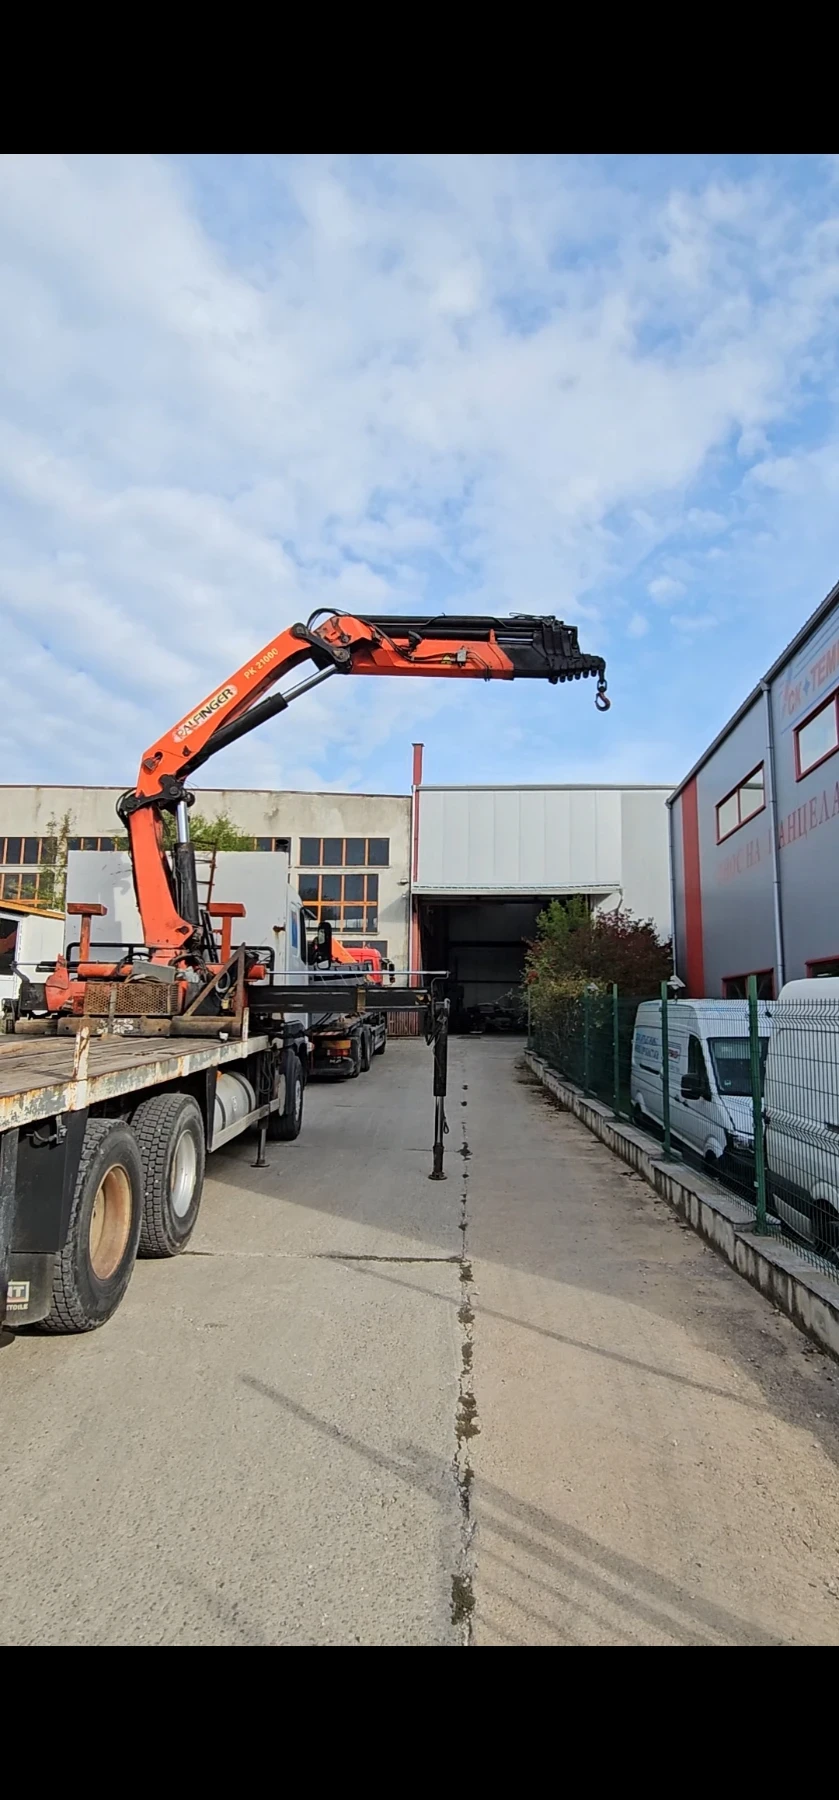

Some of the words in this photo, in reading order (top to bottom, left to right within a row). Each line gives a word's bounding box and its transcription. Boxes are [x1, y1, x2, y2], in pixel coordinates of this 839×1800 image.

[243, 666, 257, 679] PK
[255, 648, 279, 669] 21000
[175, 688, 234, 740] PALFINGER
